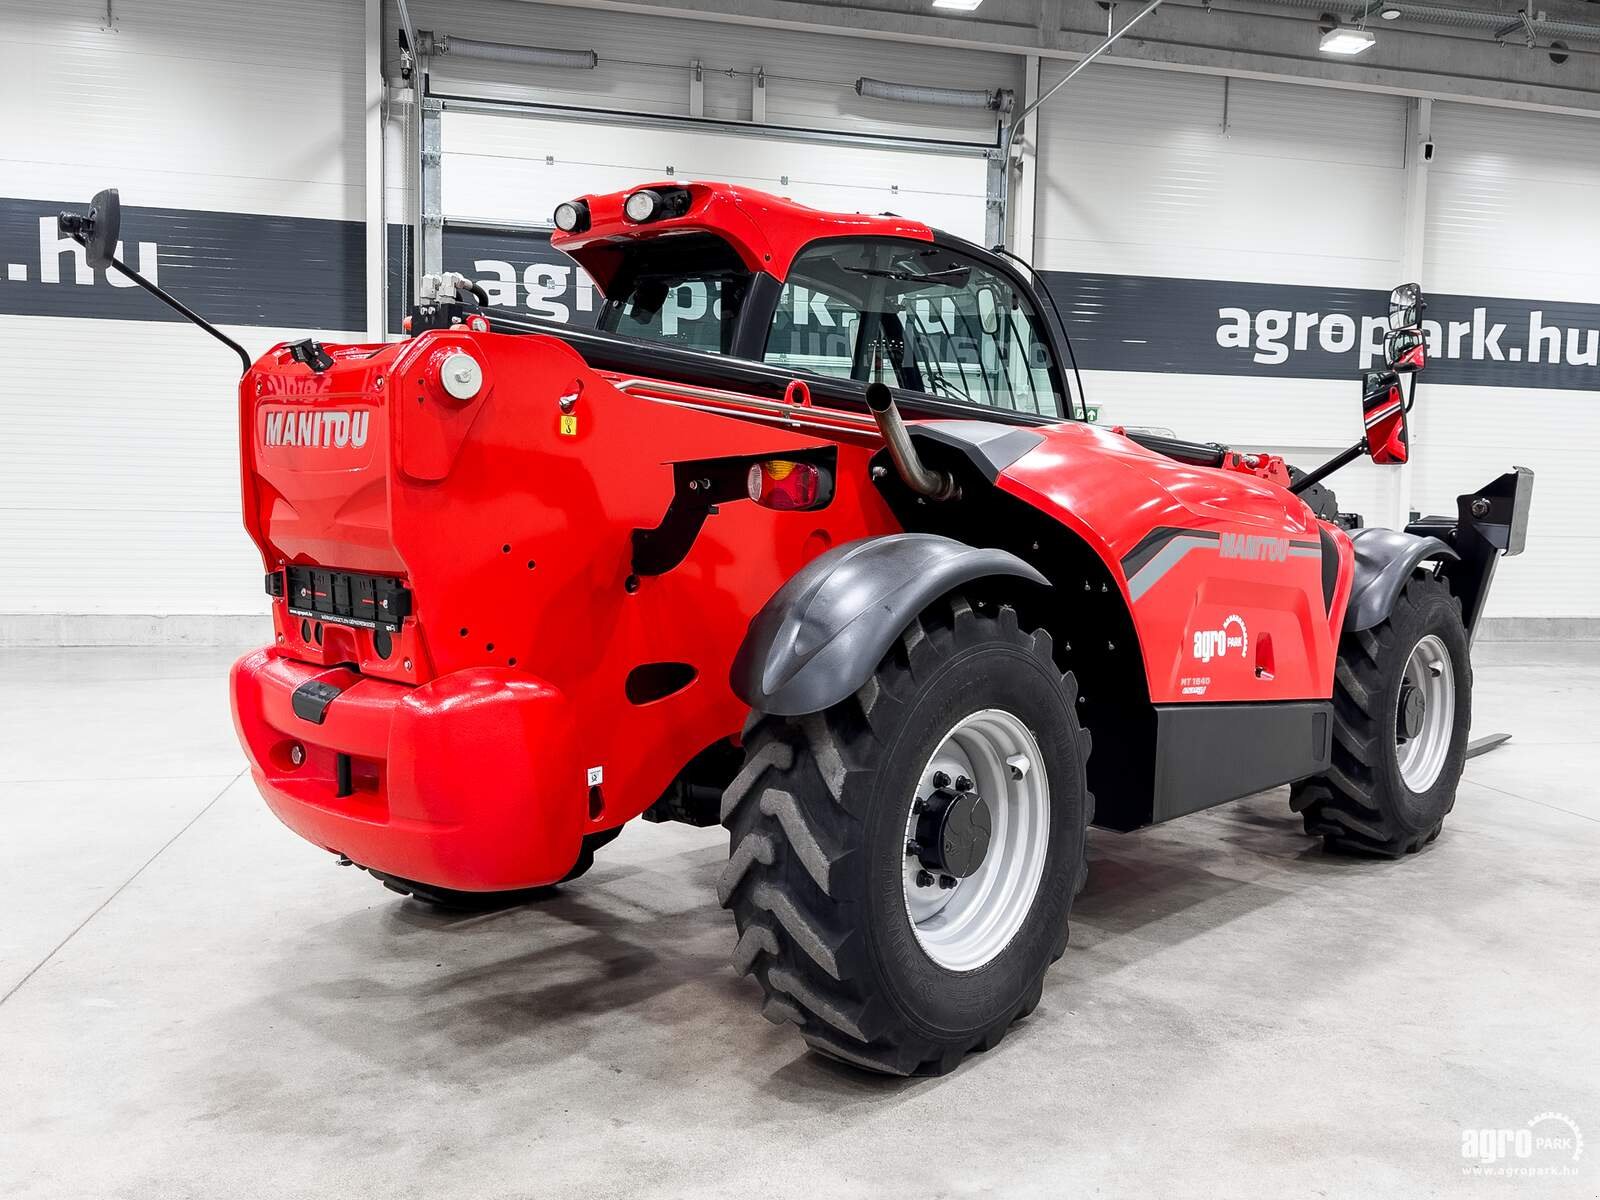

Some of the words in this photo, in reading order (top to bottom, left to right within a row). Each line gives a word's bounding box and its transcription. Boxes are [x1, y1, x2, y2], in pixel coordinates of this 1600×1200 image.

[265, 410, 370, 448] MANITOU
[1219, 532, 1291, 562] MANITOU
[1193, 630, 1227, 663] agro
